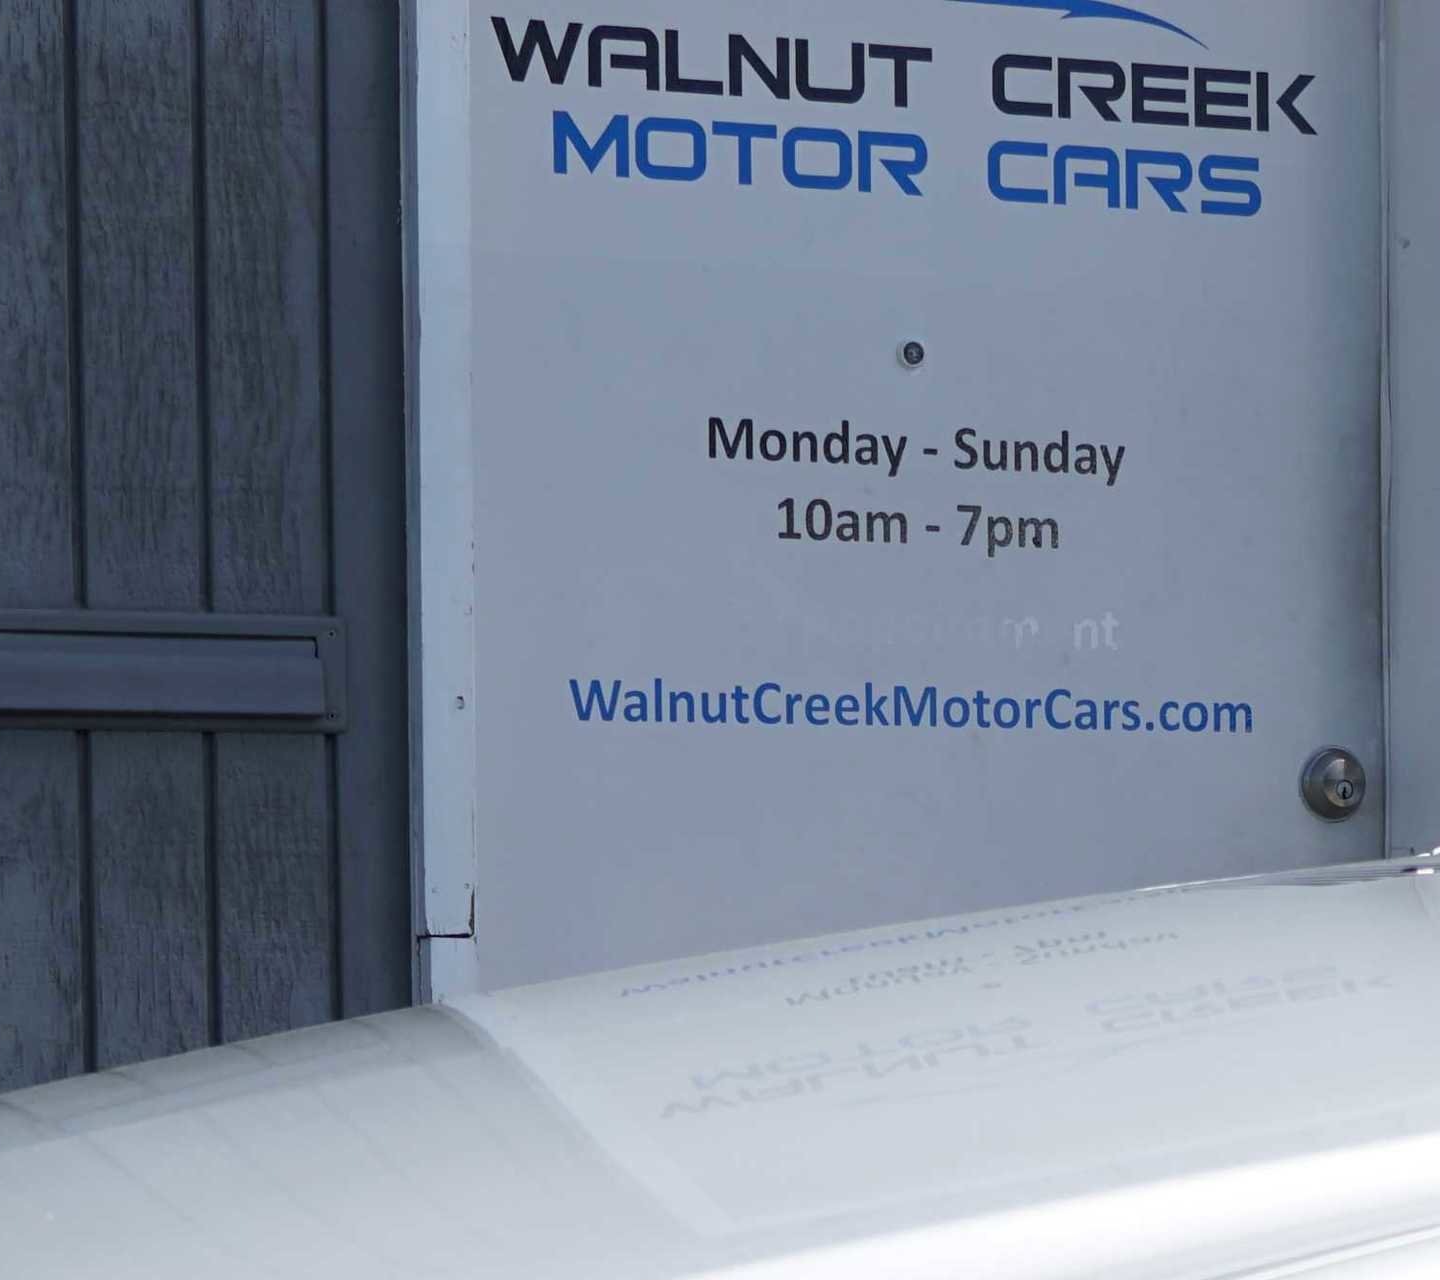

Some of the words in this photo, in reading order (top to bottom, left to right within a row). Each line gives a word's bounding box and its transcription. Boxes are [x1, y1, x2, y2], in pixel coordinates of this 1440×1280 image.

[490, 15, 933, 109] WALNUT
[991, 53, 1319, 137] CREEK
[552, 109, 929, 197] MOTOR
[987, 139, 1263, 218] CARS
[708, 416, 908, 478] Monday
[922, 447, 938, 456] -
[953, 427, 1126, 487] Sunday
[777, 497, 908, 544] 10am
[925, 524, 941, 533] -
[956, 504, 1059, 558] 7pm
[568, 677, 1253, 734] WalnutCreekMotorCars.com
